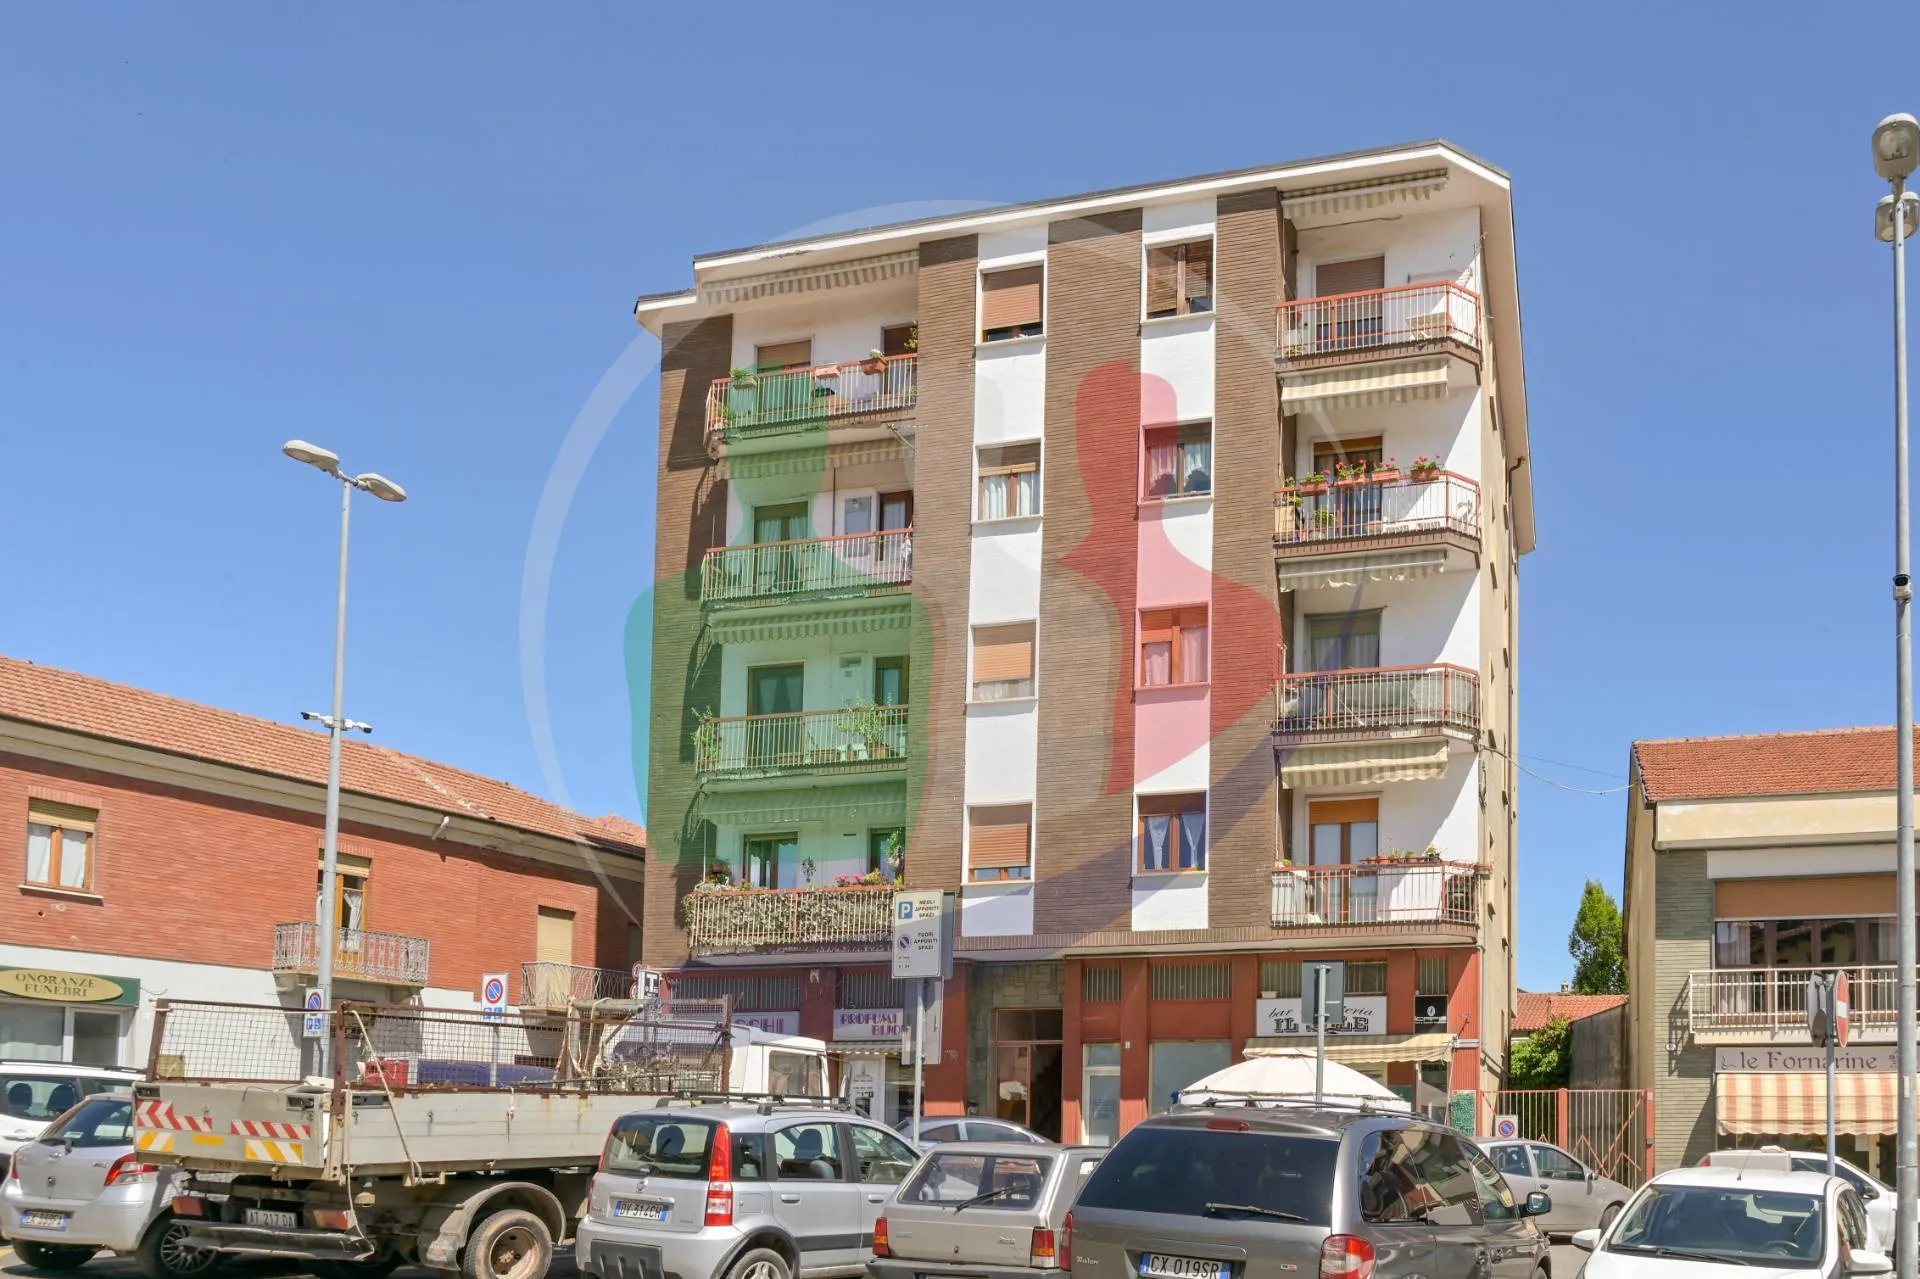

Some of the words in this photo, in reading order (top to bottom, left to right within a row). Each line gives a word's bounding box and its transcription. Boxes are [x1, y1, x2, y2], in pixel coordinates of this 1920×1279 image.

[15, 973, 97, 989] ONORANZE
[24, 983, 88, 997] FUNEBRI
[840, 1013, 897, 1024] PROFUMI
[1268, 1007, 1293, 1018] bar
[1273, 1018, 1299, 1033] IL
[1740, 1051, 1758, 1069] le
[1150, 1255, 1170, 1274] CX
[1173, 1258, 1220, 1279] 019SR
